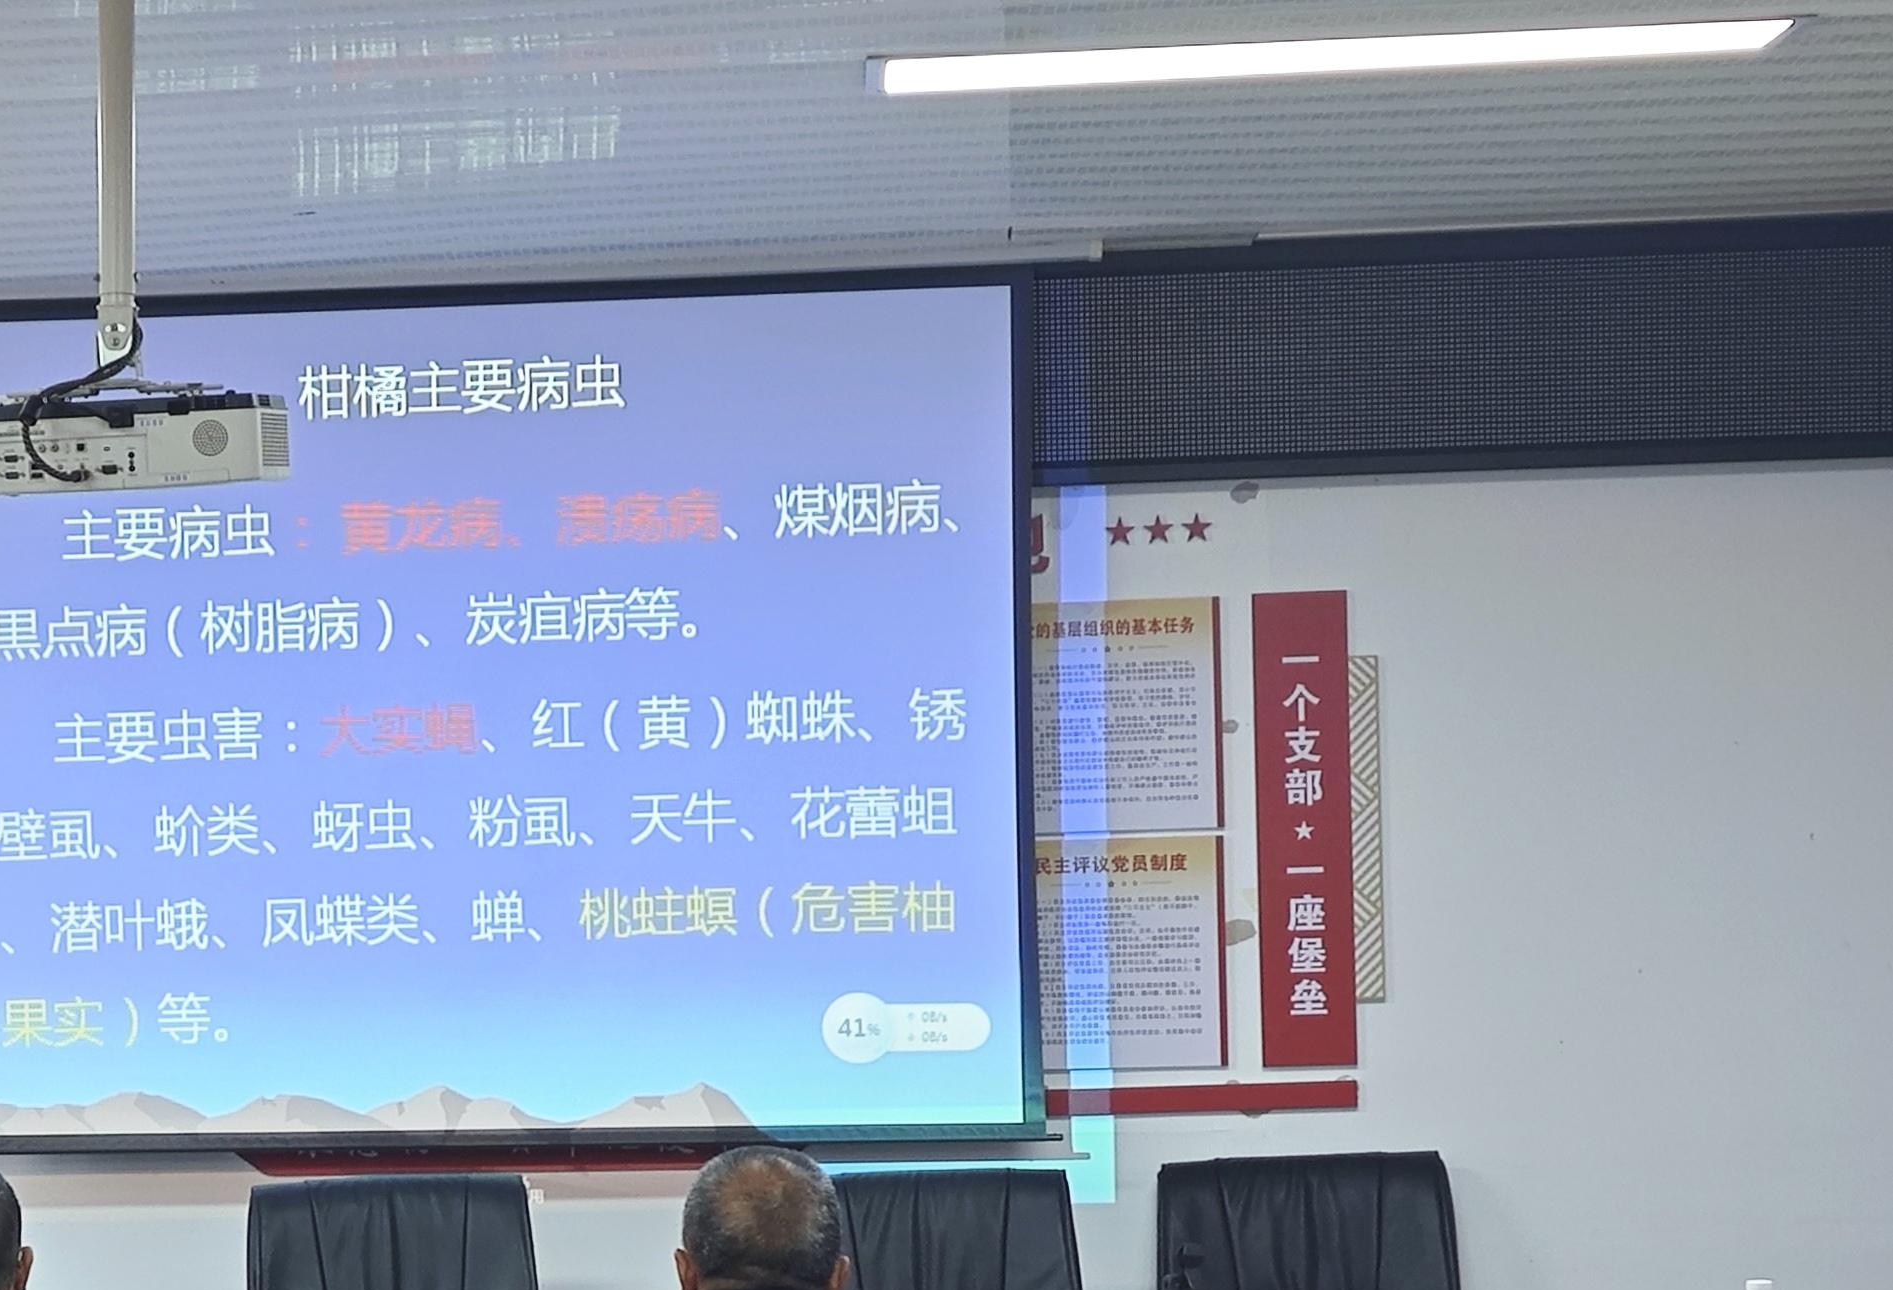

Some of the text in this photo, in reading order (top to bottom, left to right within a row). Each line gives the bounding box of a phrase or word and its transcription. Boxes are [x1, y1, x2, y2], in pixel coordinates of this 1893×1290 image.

[297, 354, 627, 420] 柑橘主要病虫
[1031, 616, 1195, 639] 的基层组织的基本任务
[1281, 654, 1330, 1017] 一个支部 一座堡垒
[1036, 853, 1187, 875] 民主评议党员制度
[838, 1018, 881, 1037] 41%
